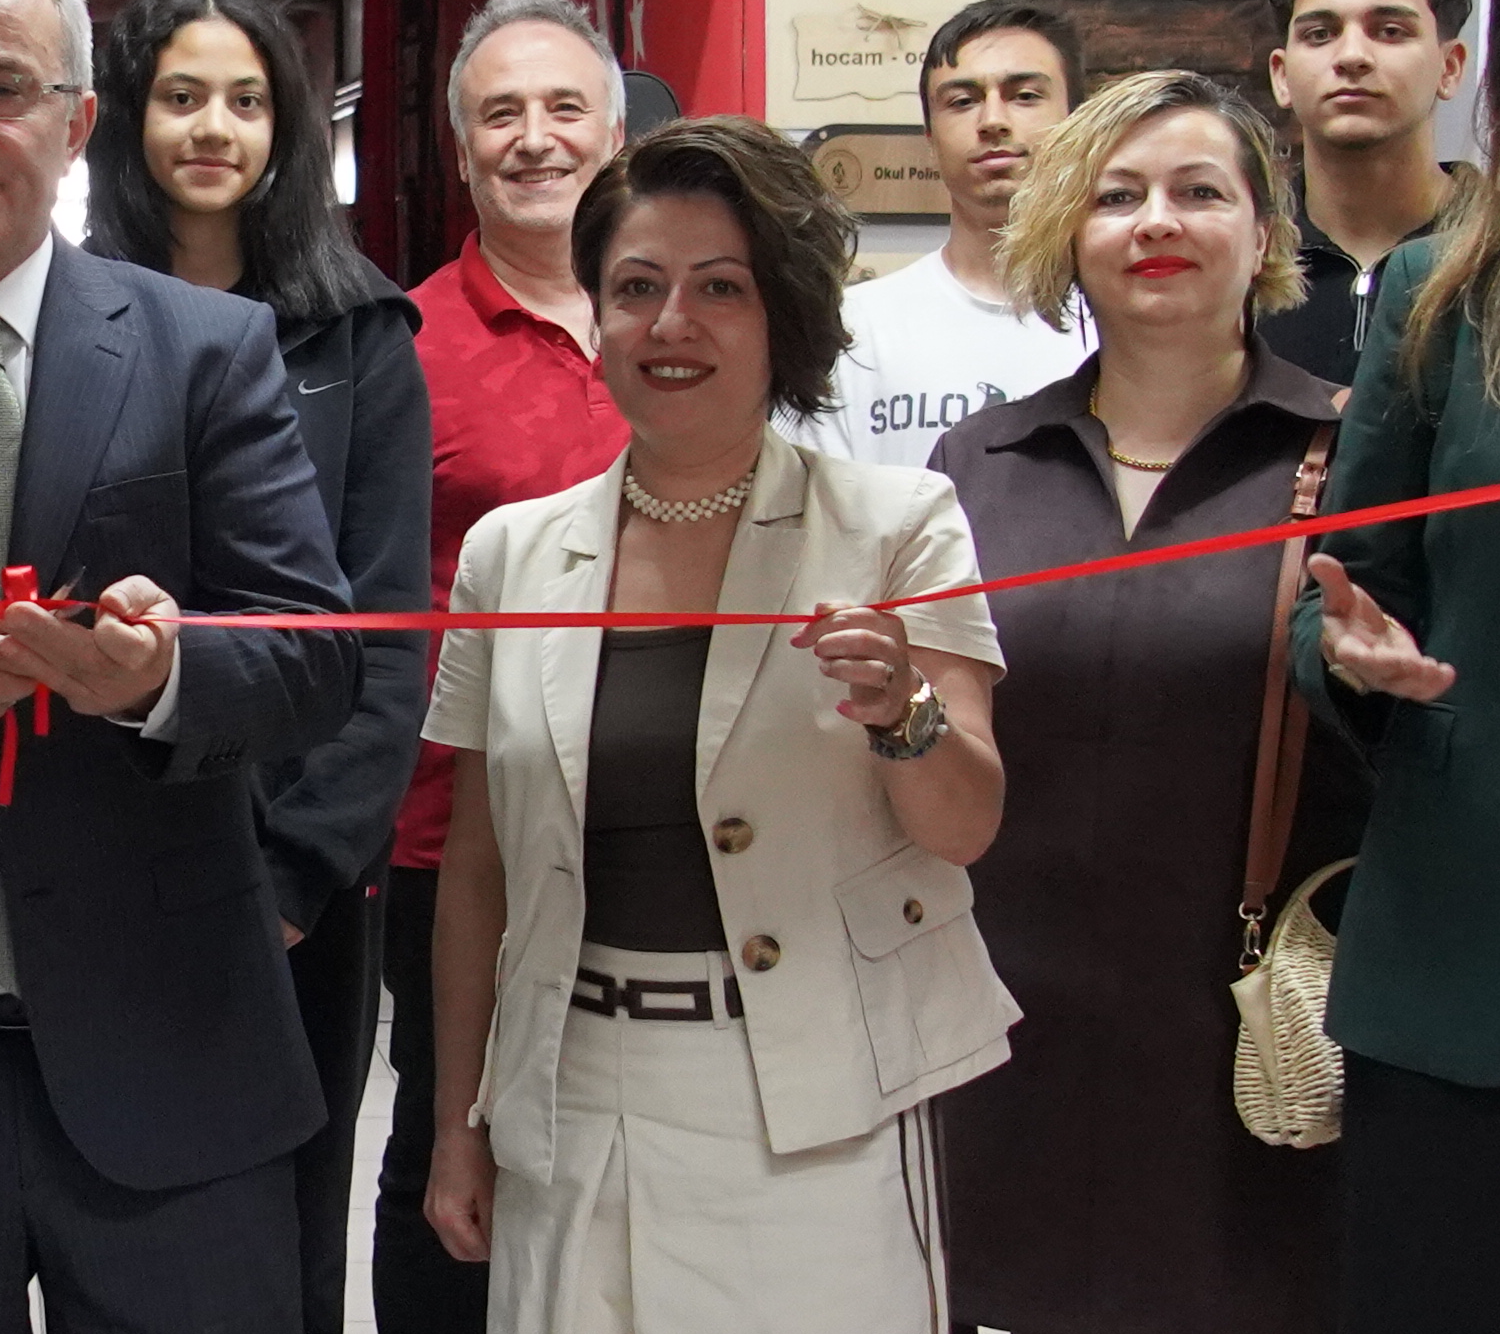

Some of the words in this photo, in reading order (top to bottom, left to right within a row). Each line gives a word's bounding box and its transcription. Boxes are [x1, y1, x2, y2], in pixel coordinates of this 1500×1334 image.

[811, 48, 883, 67] hocam
[873, 165, 905, 181] Okul
[869, 391, 970, 436] SOLO
